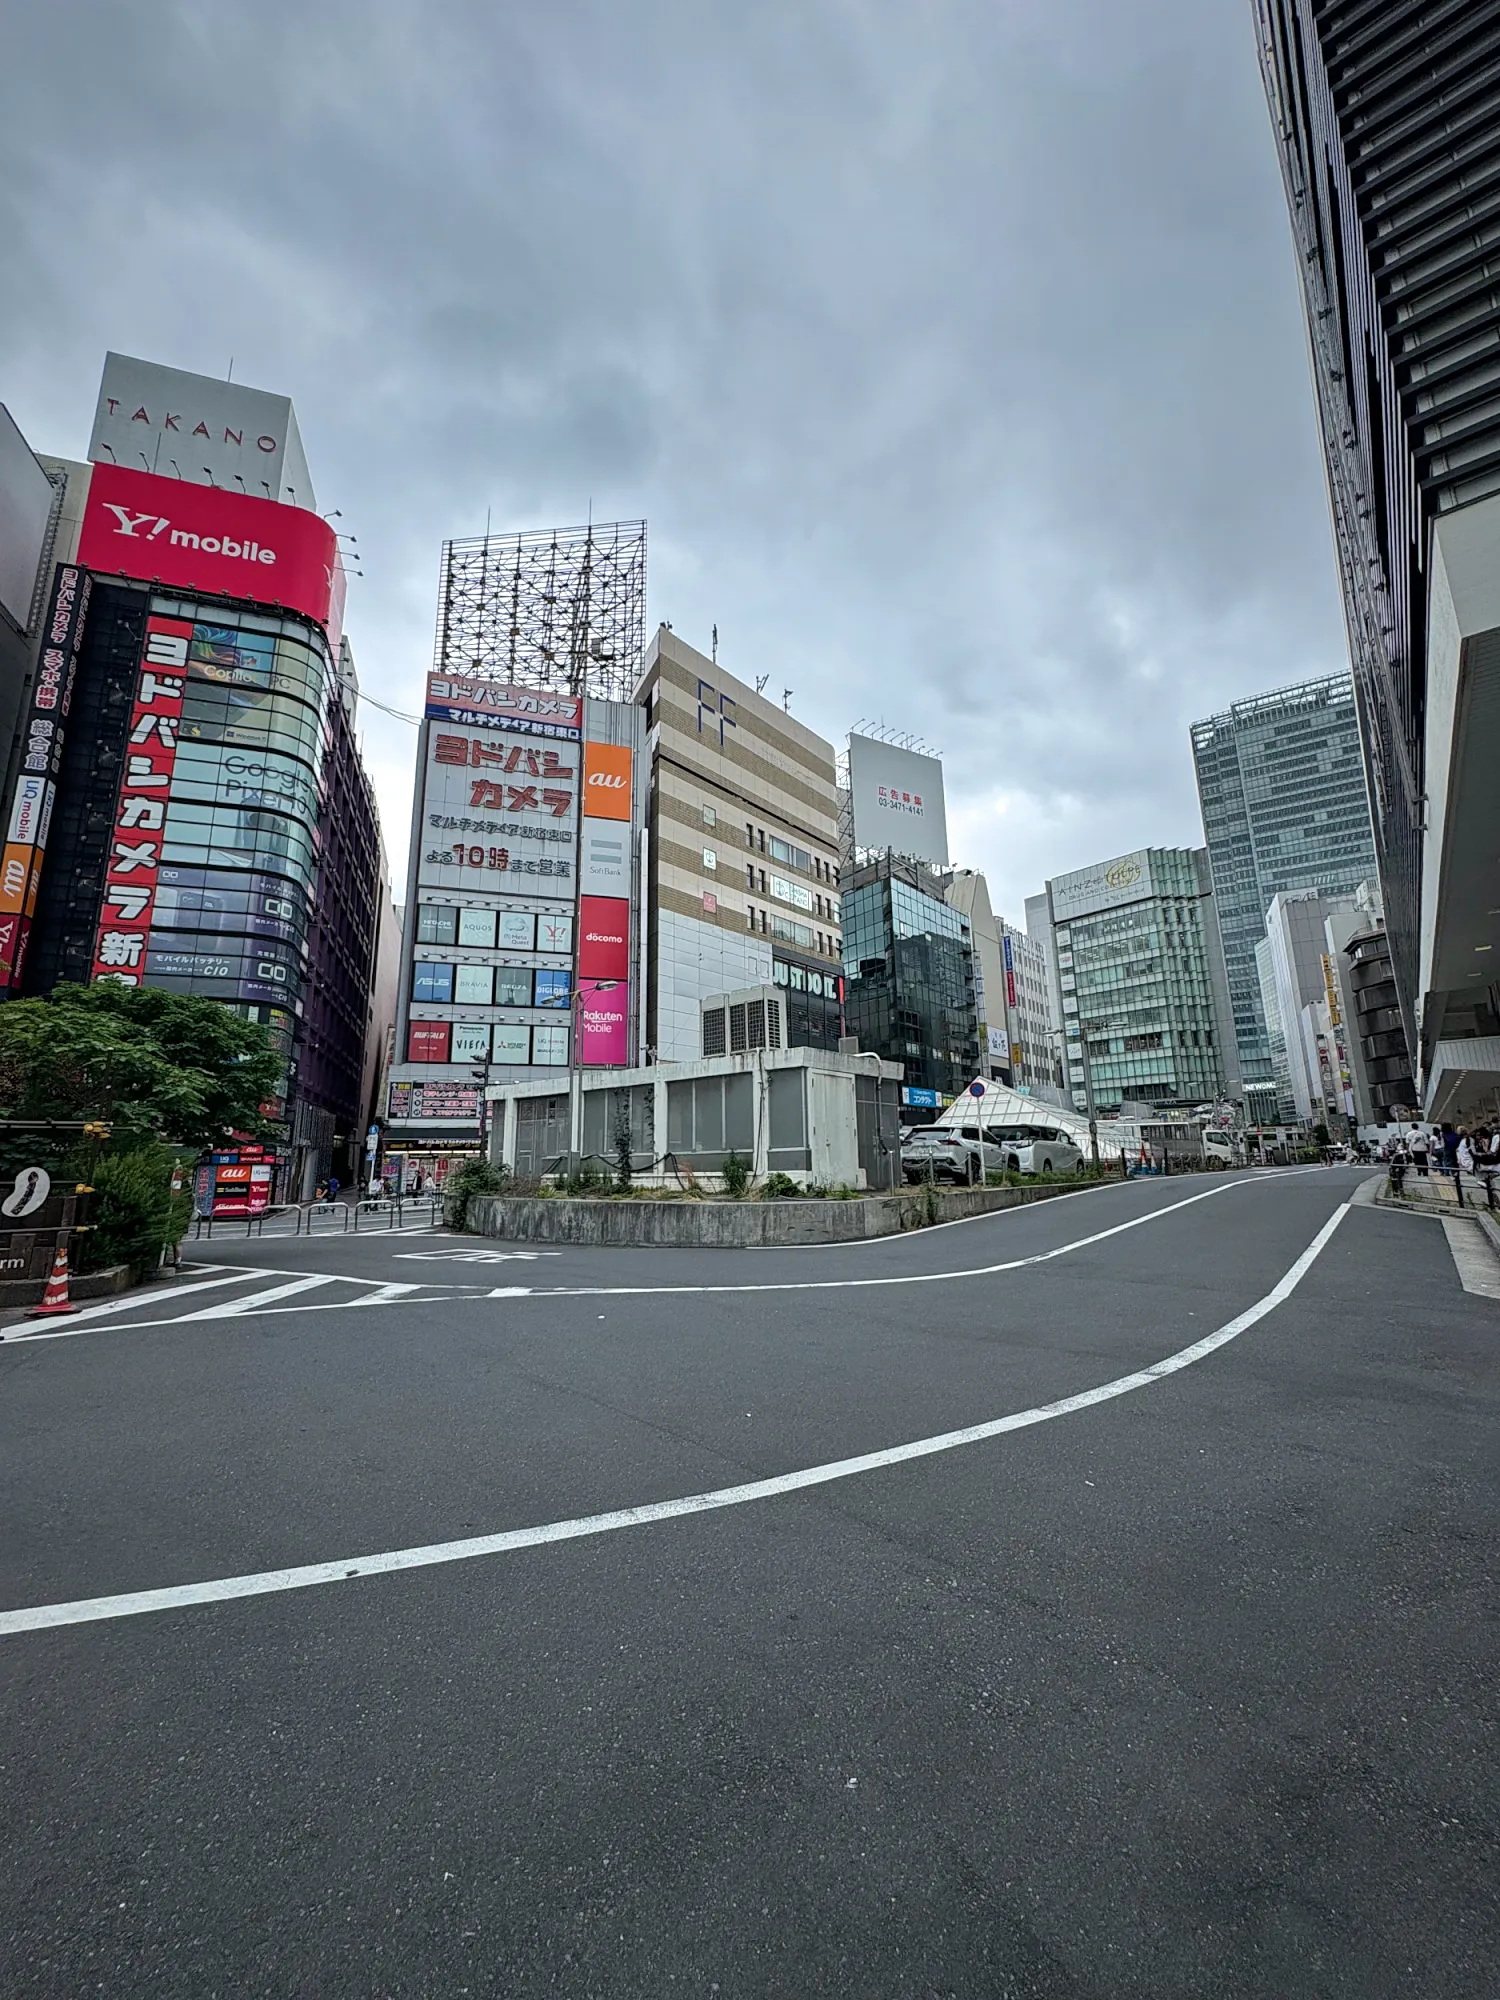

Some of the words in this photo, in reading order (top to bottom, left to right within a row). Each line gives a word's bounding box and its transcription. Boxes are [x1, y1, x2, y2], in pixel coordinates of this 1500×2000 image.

[107, 398, 277, 453] TAKANO
[50, 568, 78, 643] ヨドバシカメラ
[430, 678, 580, 720] ヨドバシカメラ
[24, 719, 54, 772] 総合館
[434, 733, 574, 779] ヨドバシ
[225, 755, 309, 793] Google
[588, 771, 628, 790] au
[469, 778, 573, 818] カメラ
[878, 786, 923, 807] 広告募集
[878, 797, 924, 818] 03-3471-4141
[16, 801, 32, 840] mobile
[425, 843, 571, 878] よる10時まで営業
[590, 865, 622, 877] SoftBank
[3, 858, 25, 899] au
[463, 923, 493, 932] AQUOS
[416, 976, 451, 987] ASUS
[459, 980, 489, 989] BRAVIA
[583, 1010, 623, 1022] Rakuten
[221, 1168, 247, 1178] au
